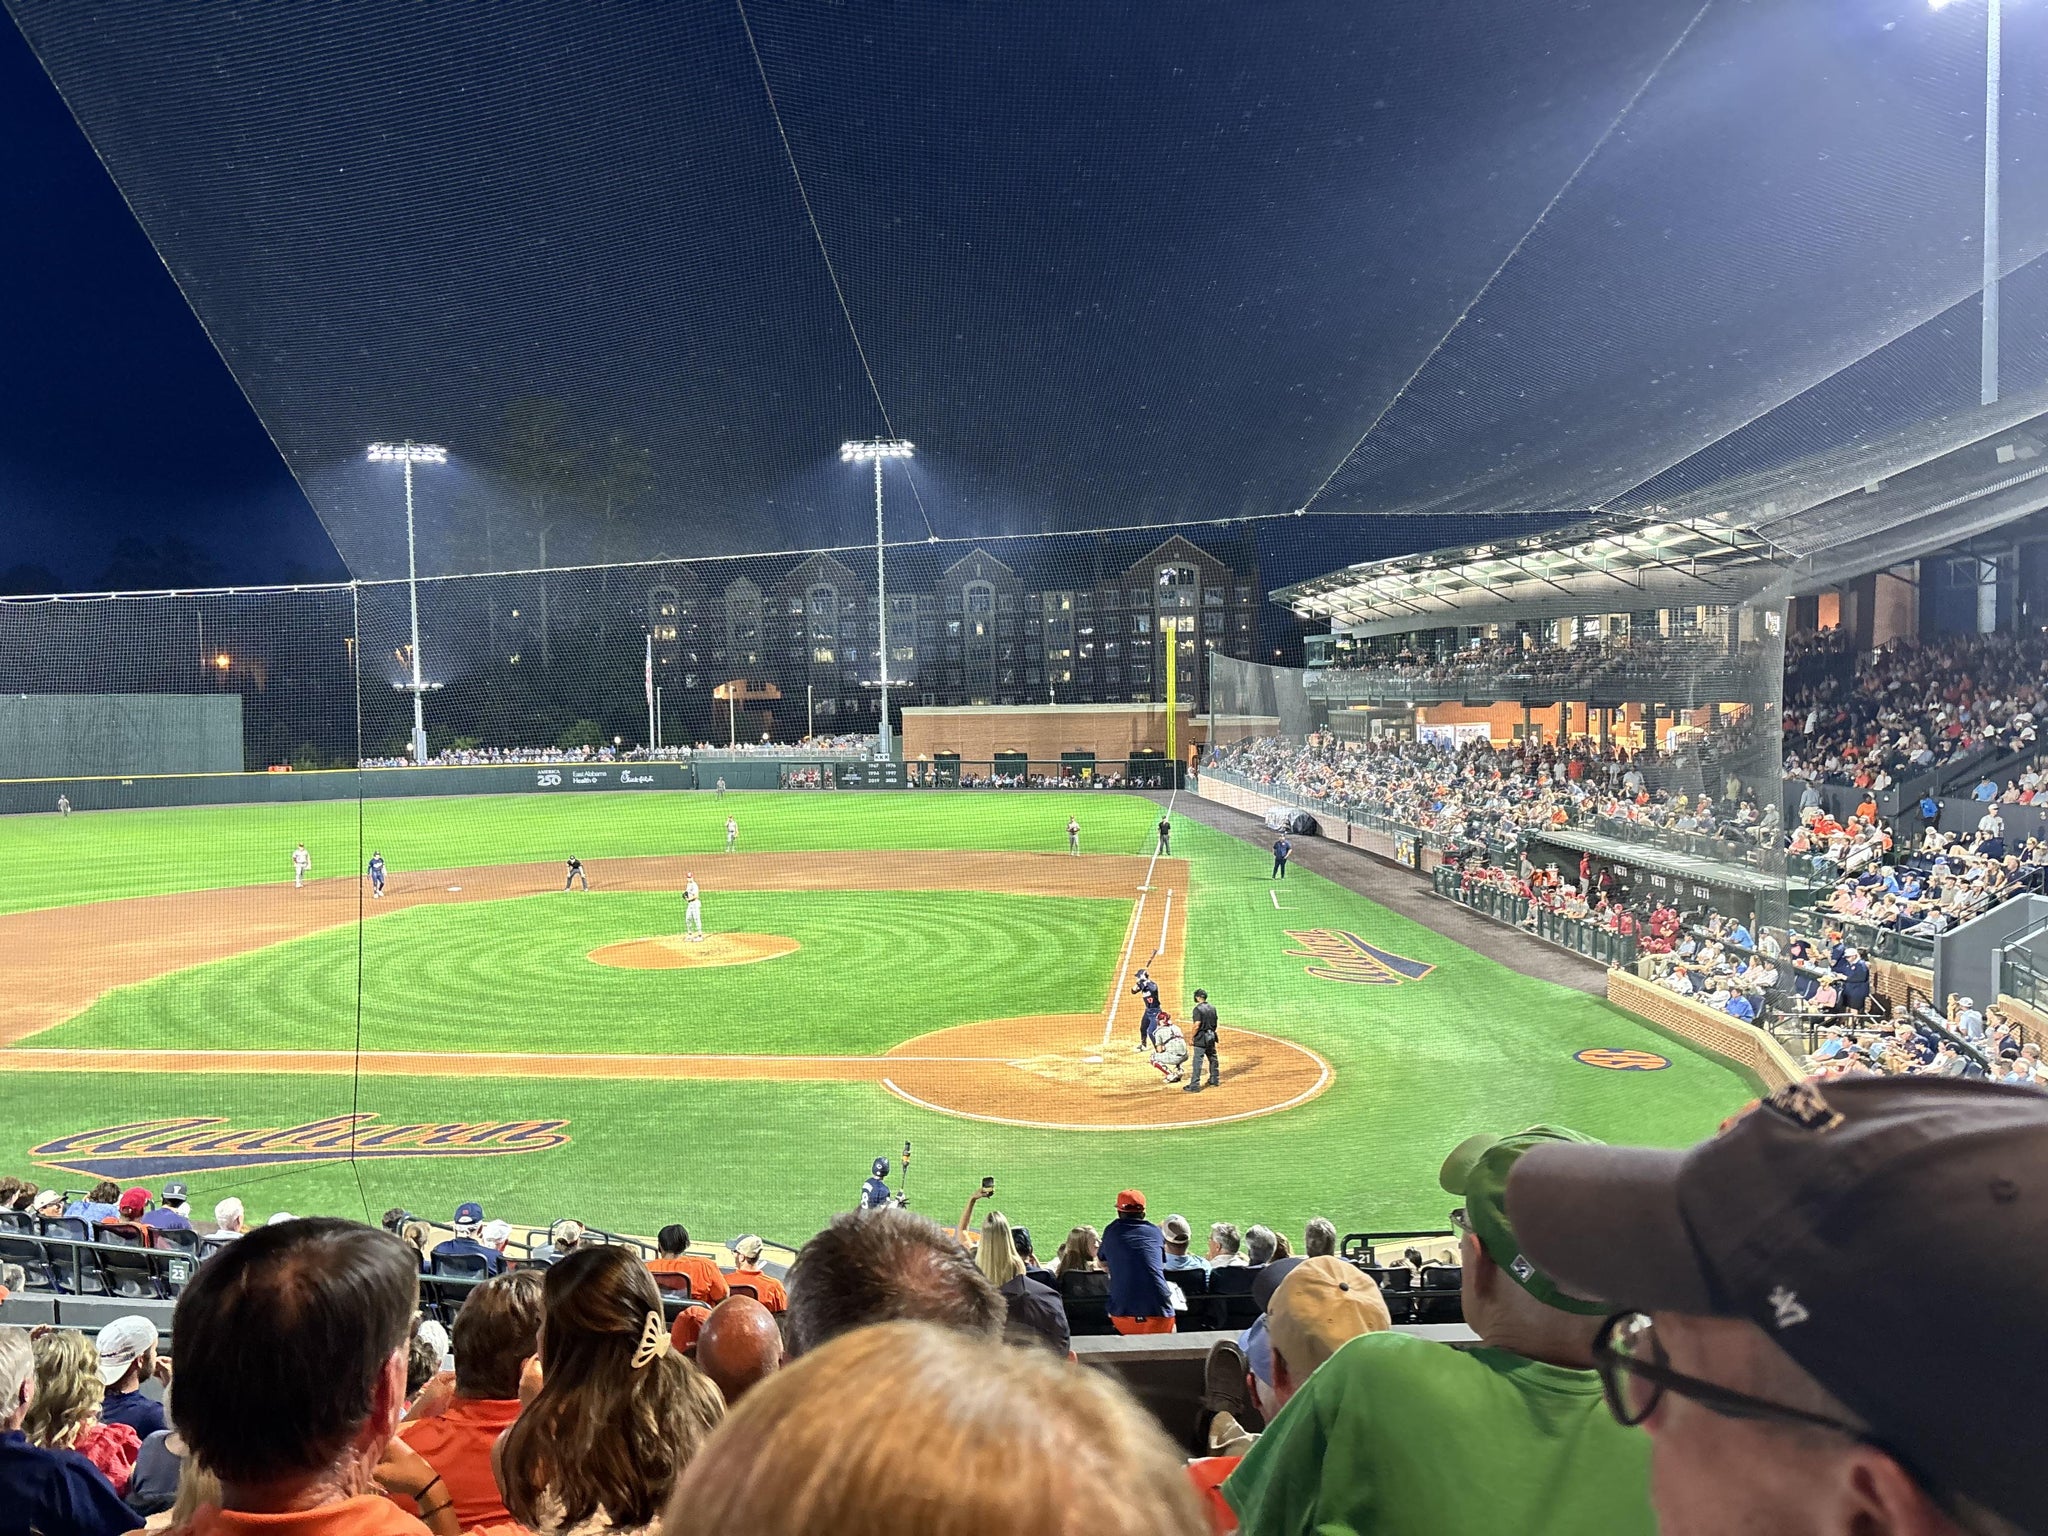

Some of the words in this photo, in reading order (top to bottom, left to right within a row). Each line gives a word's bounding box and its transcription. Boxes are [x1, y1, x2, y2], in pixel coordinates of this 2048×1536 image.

[537, 775, 561, 786] 250
[1613, 864, 1628, 877] YETI
[1650, 874, 1666, 888] YETI
[1692, 885, 1710, 899] YETI
[28, 1112, 571, 1182] Auburn
[1359, 1254, 1371, 1263] 21
[171, 1269, 185, 1280] 23
